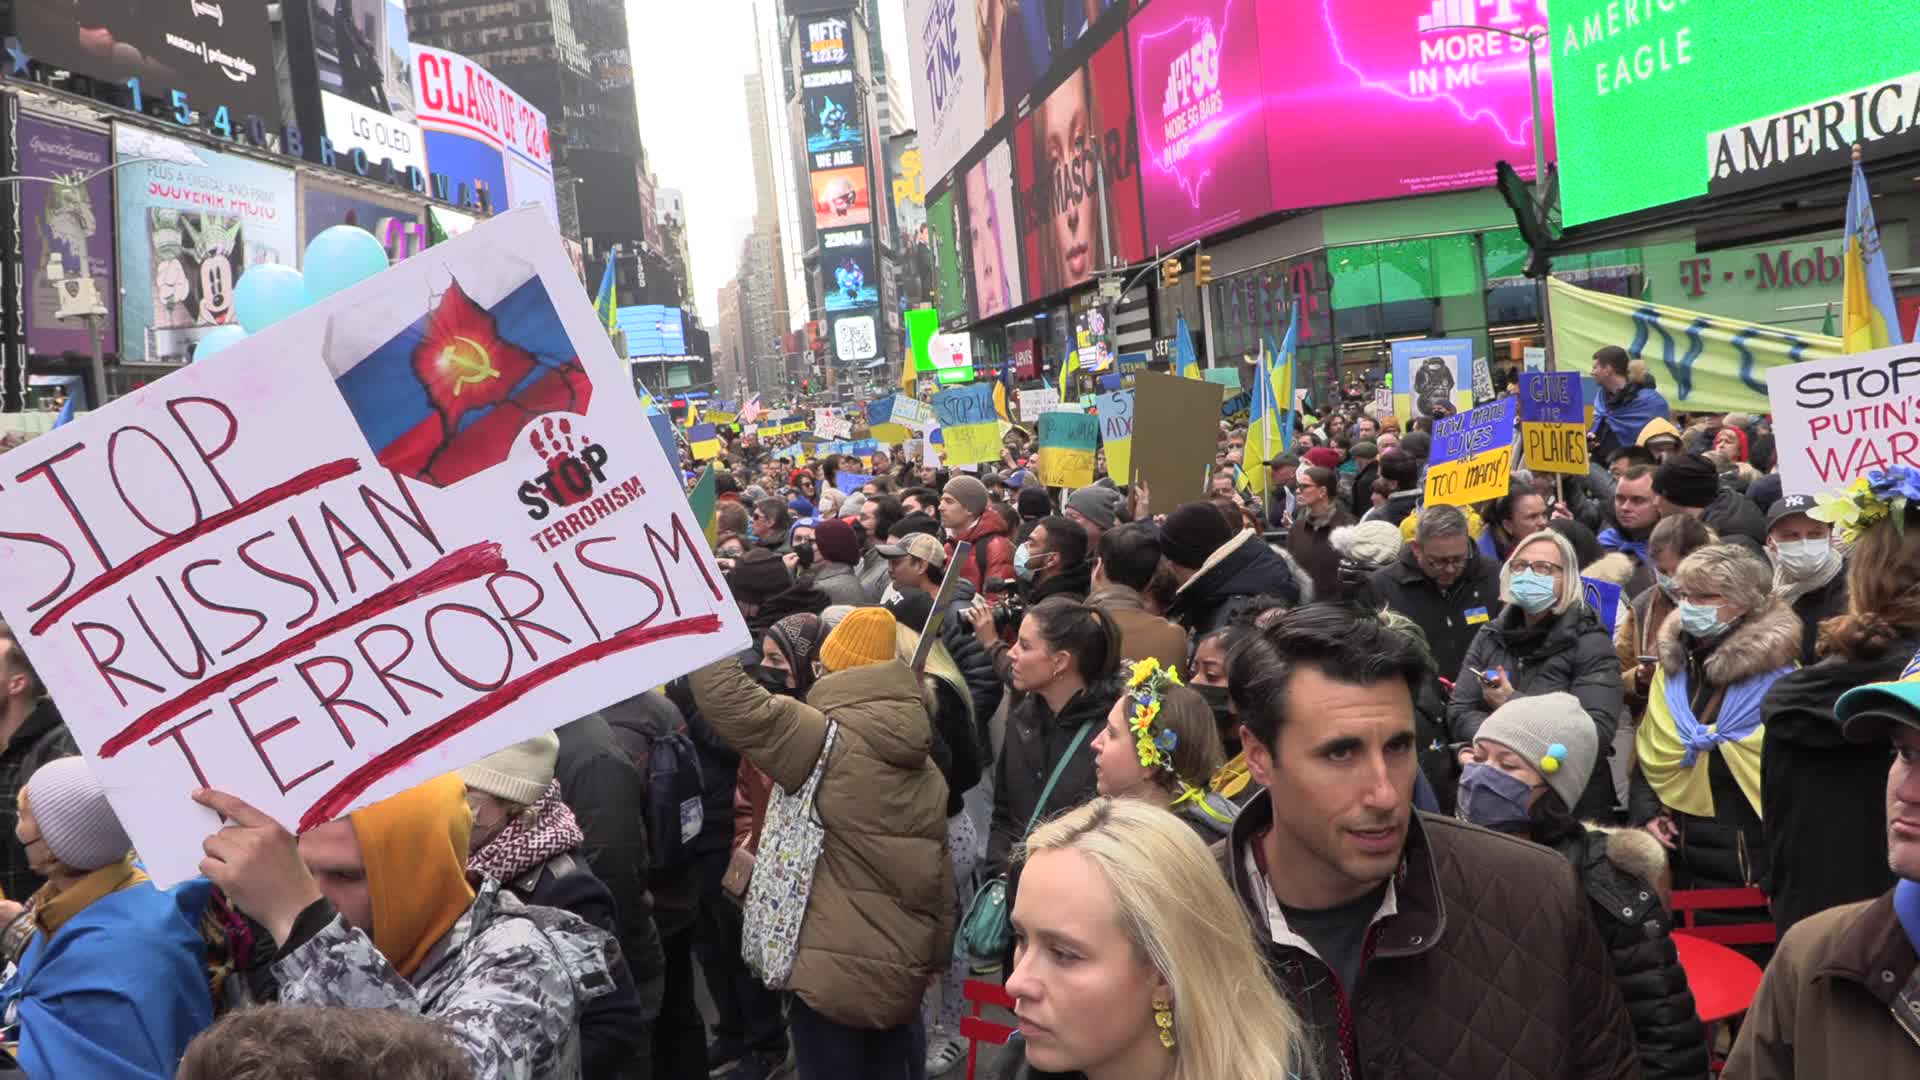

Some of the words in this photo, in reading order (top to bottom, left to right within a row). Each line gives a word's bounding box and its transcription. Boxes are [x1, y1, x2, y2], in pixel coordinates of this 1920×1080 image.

[1420, 31, 1503, 65] MORE
[1596, 28, 1692, 96] EAGLE
[418, 53, 498, 133] CLASS
[500, 89, 516, 144] OF
[1409, 67, 1438, 95] IN
[351, 112, 370, 140] LG
[375, 123, 411, 154] OLED
[833, 150, 854, 166] ARE
[1530, 375, 1569, 404] GIVE
[1796, 356, 1920, 409] STOP
[1446, 424, 1493, 457] LIVES
[1808, 395, 1920, 440] PUTIN'
[1805, 431, 1920, 482] WAR
[517, 443, 608, 521] STOP
[1431, 470, 1458, 497] TOO
[530, 475, 647, 553] TERRORISM
[72, 469, 445, 706] RUSSIAN
[148, 512, 724, 824] TERRORISM
